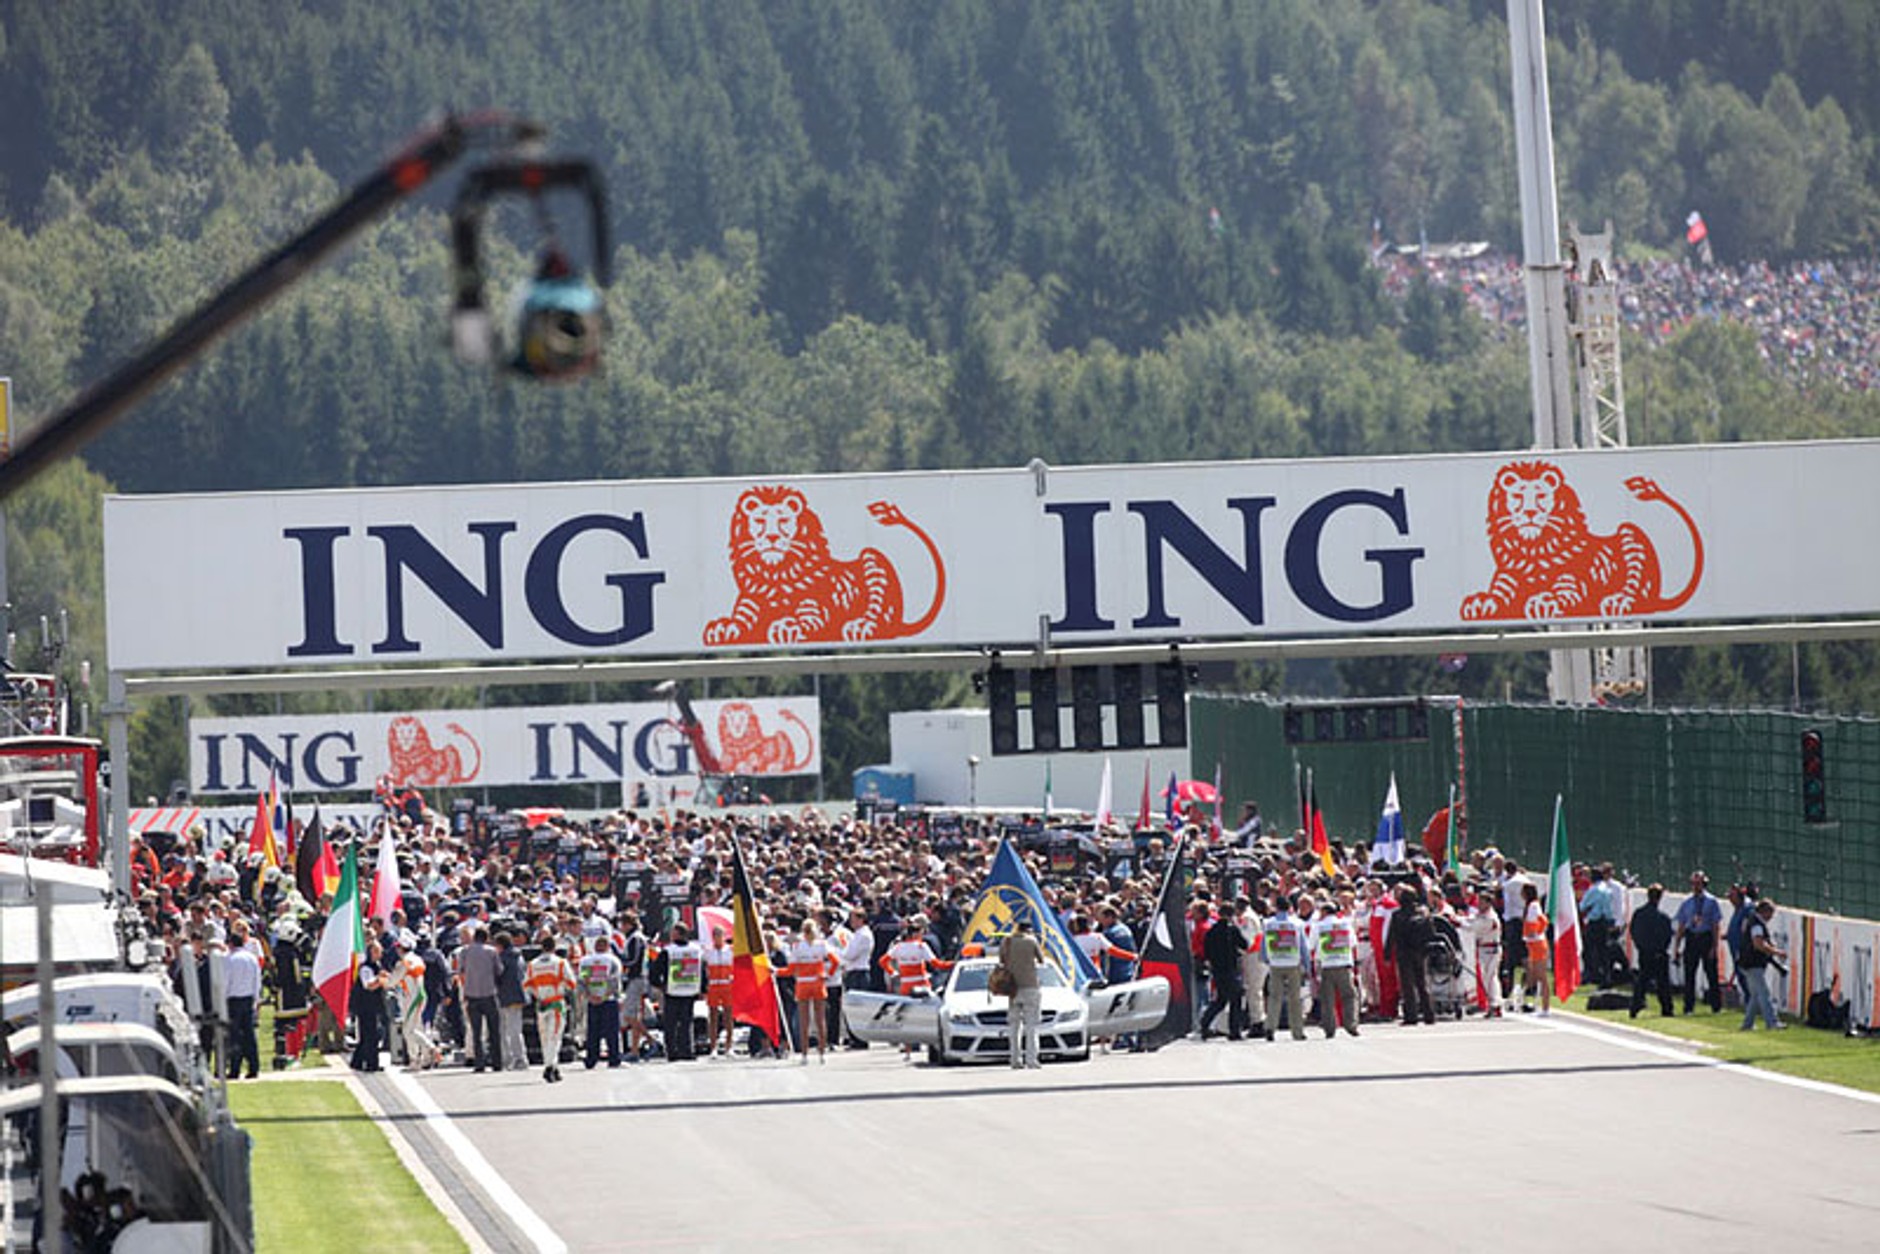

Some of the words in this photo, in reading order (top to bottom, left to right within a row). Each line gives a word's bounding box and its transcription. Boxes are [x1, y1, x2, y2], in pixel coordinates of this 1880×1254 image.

[283, 511, 666, 657] ING
[1044, 487, 1425, 632] ING
[199, 731, 363, 791] ING
[527, 718, 694, 781] ING
[1108, 991, 1137, 1014] F1
